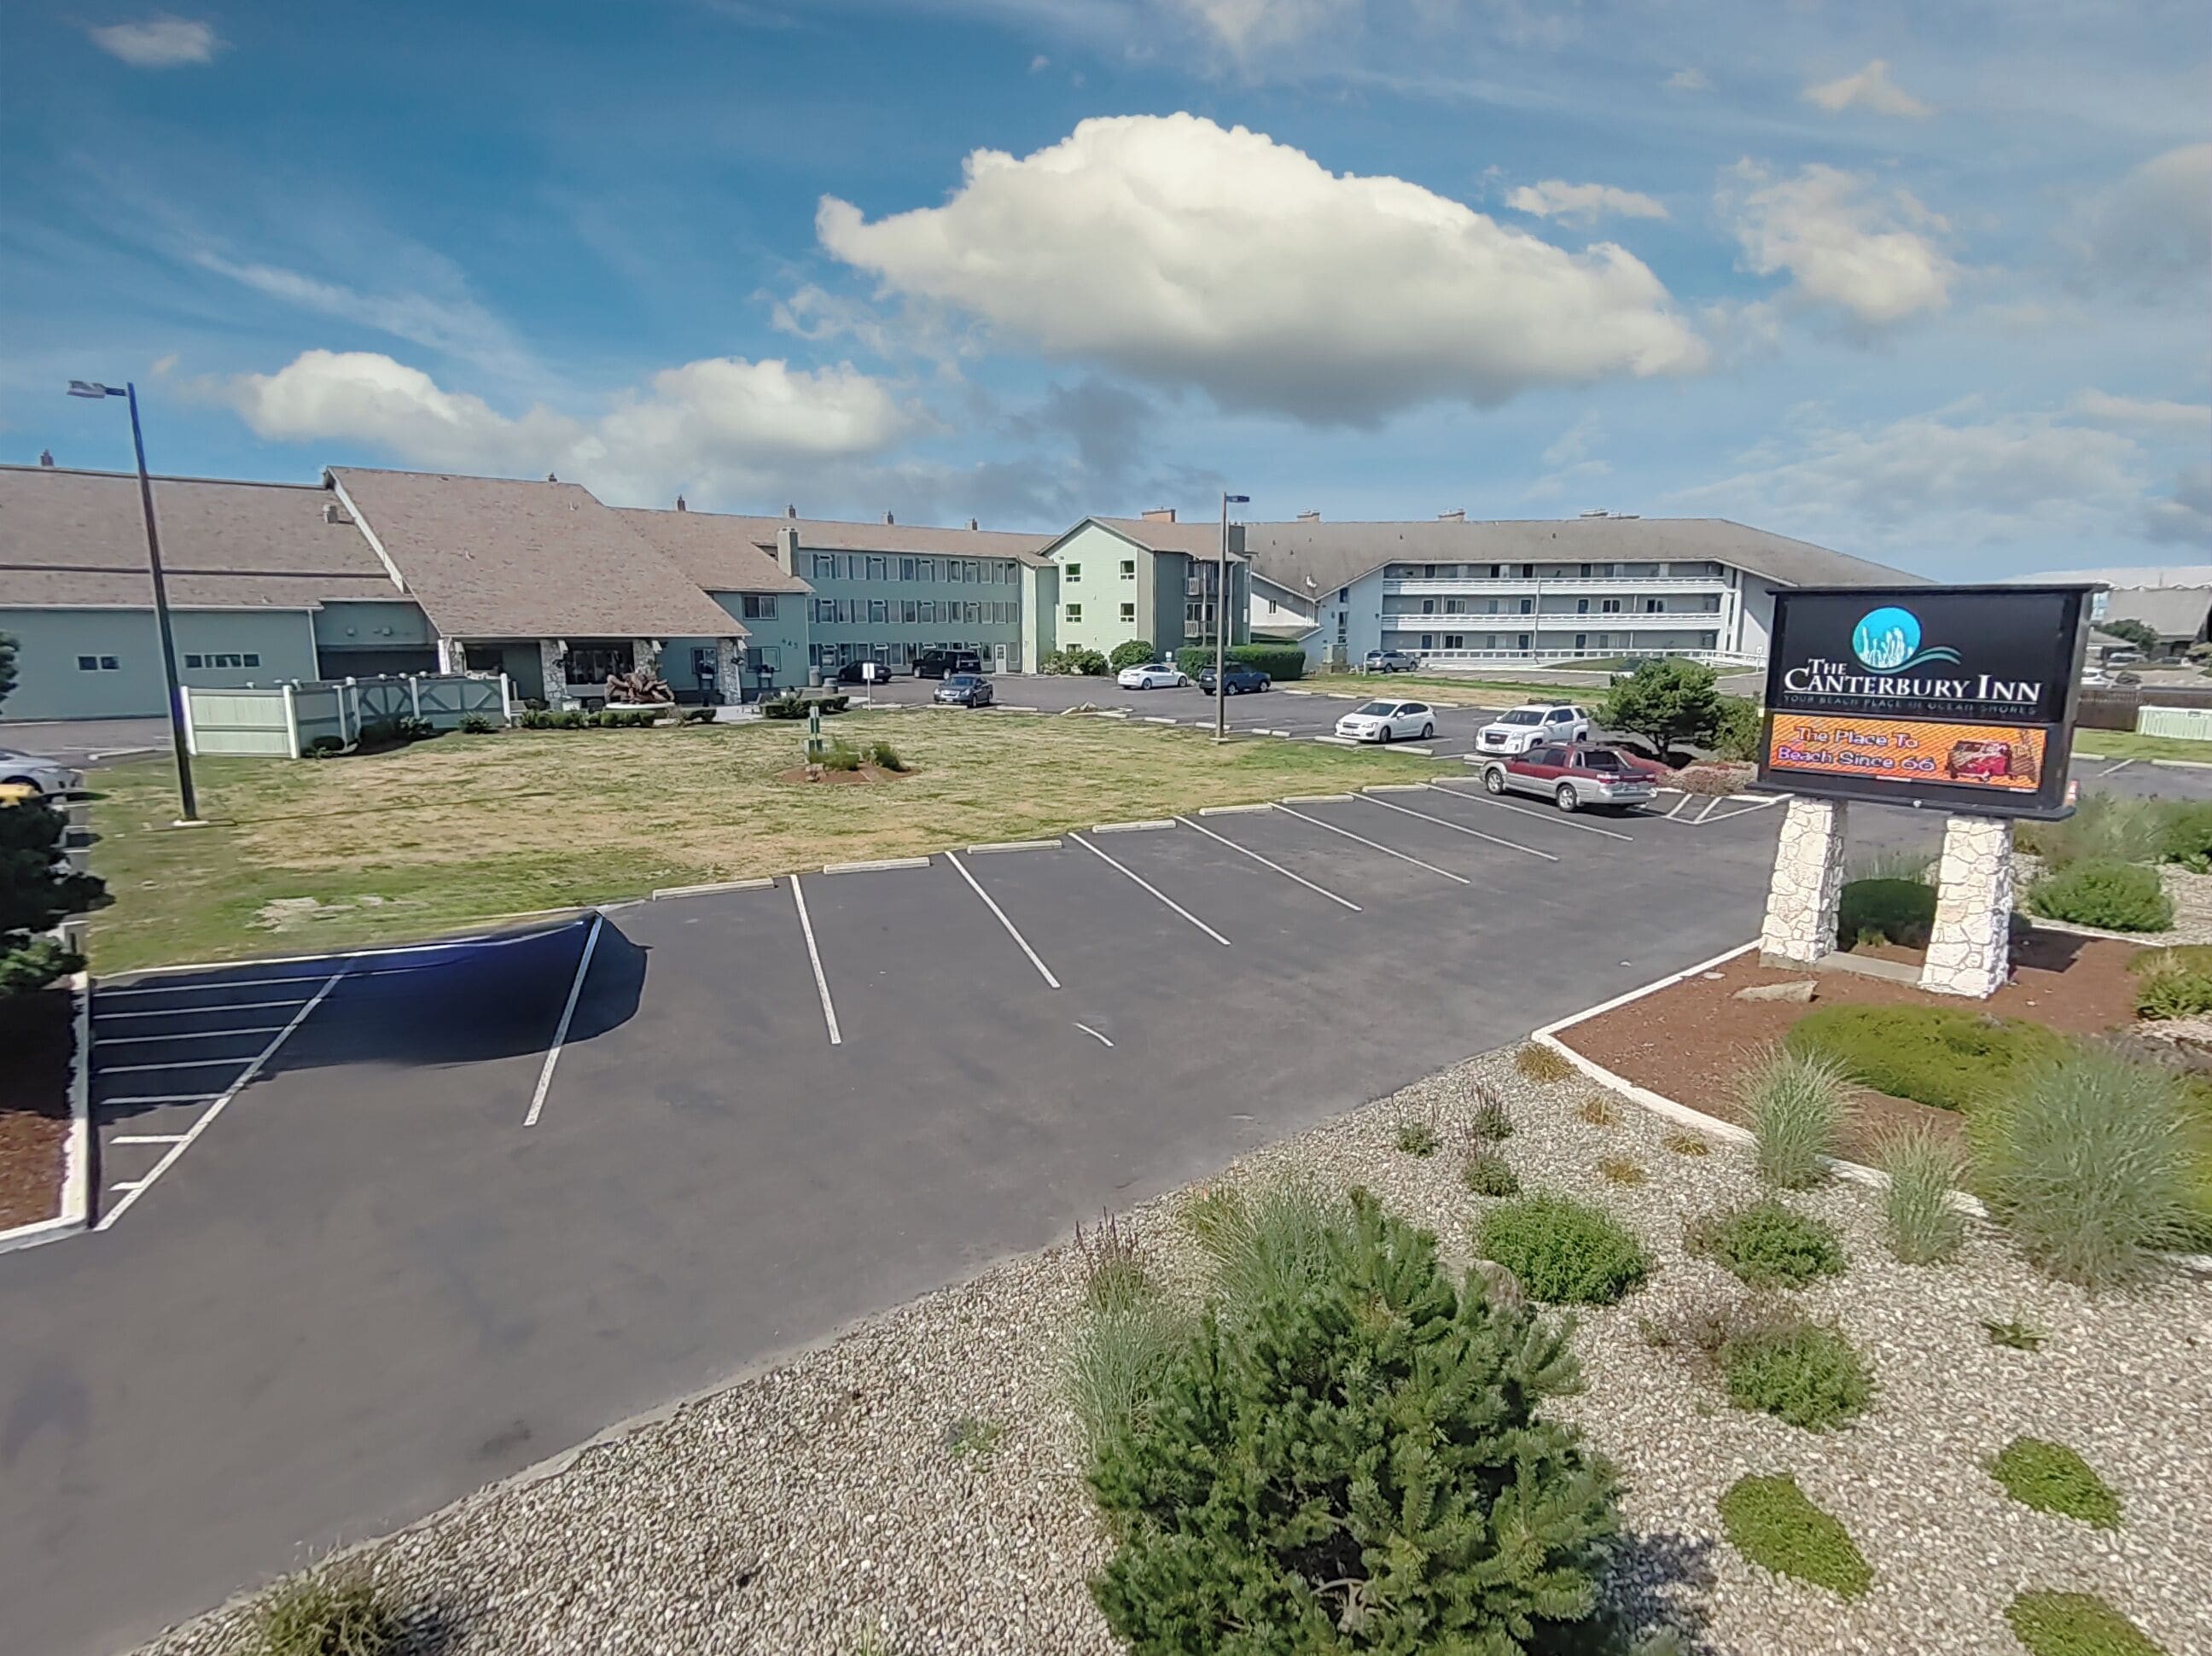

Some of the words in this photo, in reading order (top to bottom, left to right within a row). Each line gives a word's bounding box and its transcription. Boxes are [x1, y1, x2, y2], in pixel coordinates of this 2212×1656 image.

[1807, 658, 1848, 675] THE
[1784, 667, 1970, 698] CANTERBURY
[1976, 674, 2042, 702] INN
[1784, 694, 1814, 703] YOUR
[1819, 696, 1859, 705] BEACH
[1864, 698, 1901, 708] PLACE
[1927, 702, 1973, 711] OCEAN
[1980, 704, 2037, 715] SHORES
[1796, 727, 1828, 742] The
[1835, 730, 1888, 746] Place
[1895, 733, 1918, 748] To
[1778, 747, 1833, 763] Beach
[1839, 752, 1895, 768] Since
[1901, 757, 1935, 772] 66
